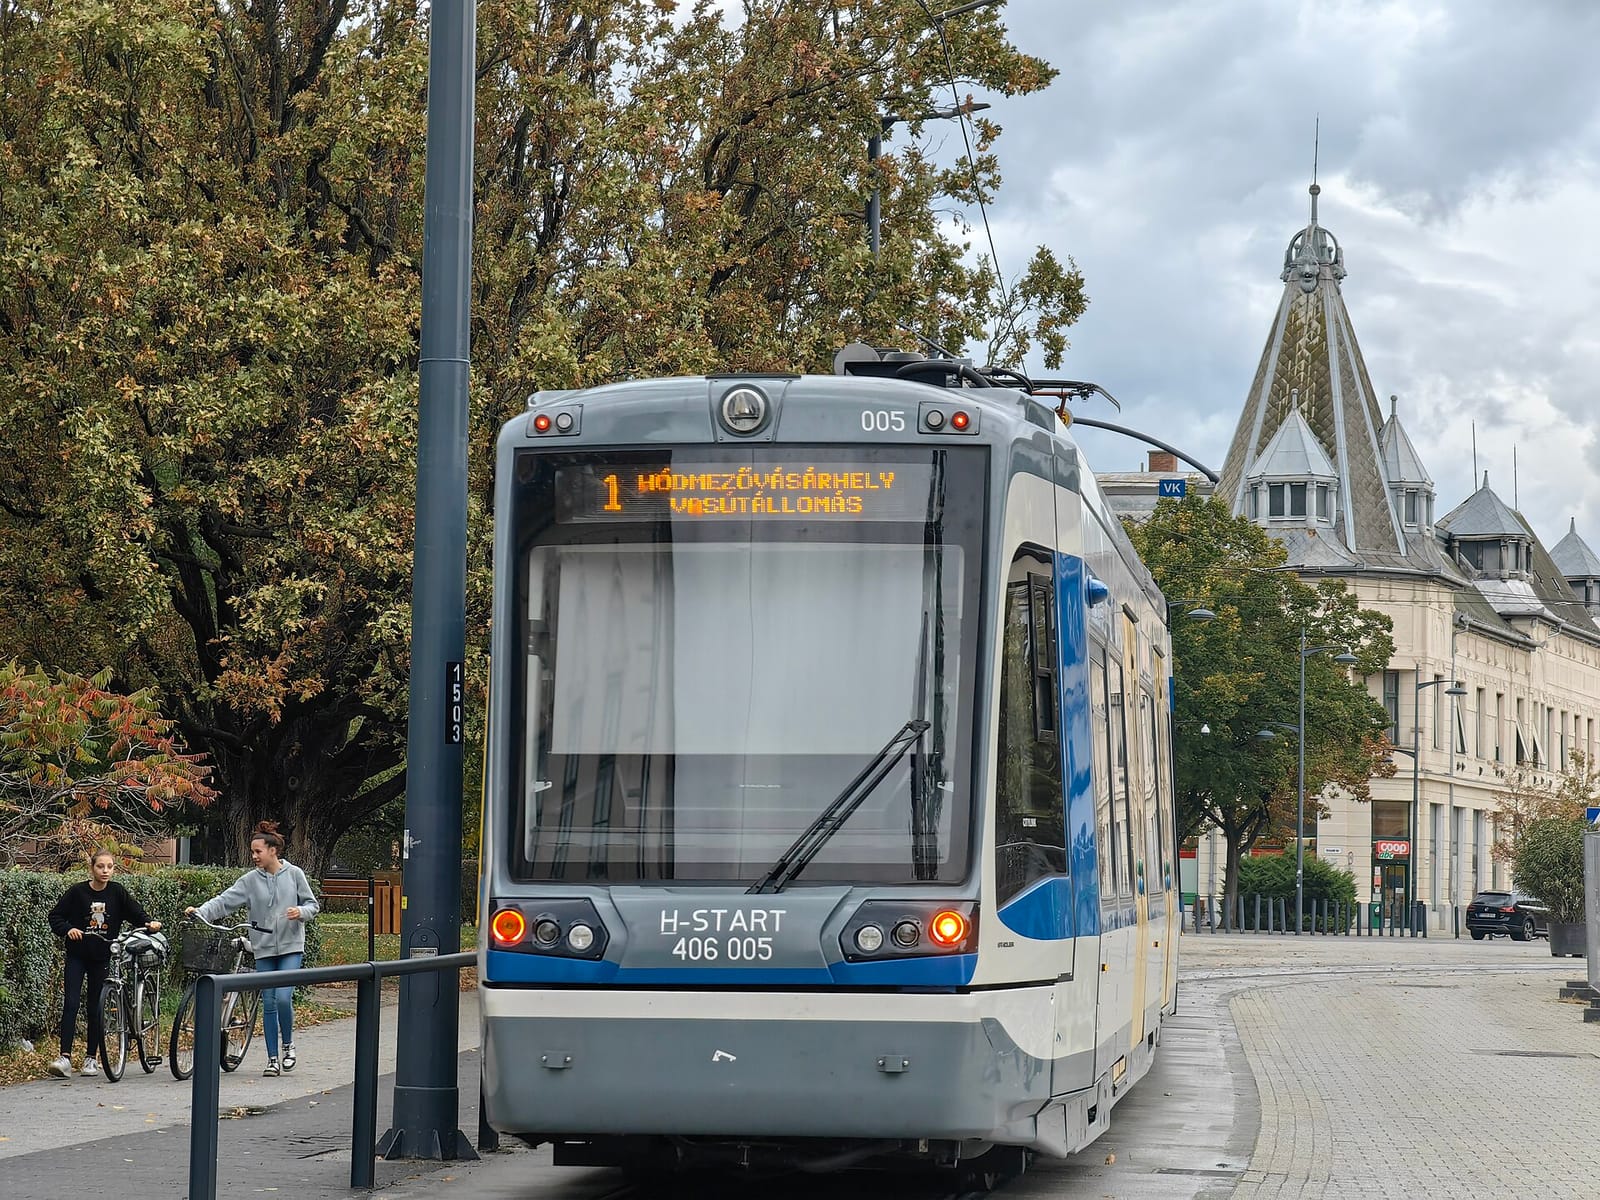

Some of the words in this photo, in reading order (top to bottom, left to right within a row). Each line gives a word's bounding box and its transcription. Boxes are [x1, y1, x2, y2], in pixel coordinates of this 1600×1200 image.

[861, 410, 905, 431] 005
[637, 466, 895, 491] HÓDMEZŐVÁSÁRHELY
[1163, 483, 1181, 493] VK
[603, 474, 621, 511] 1
[670, 490, 863, 514] VASÚTÁLLOMÁS
[453, 663, 461, 742] 1503
[1380, 843, 1407, 854] coop
[660, 909, 787, 934] H-START
[672, 937, 718, 960] 406
[727, 937, 773, 960] 005
